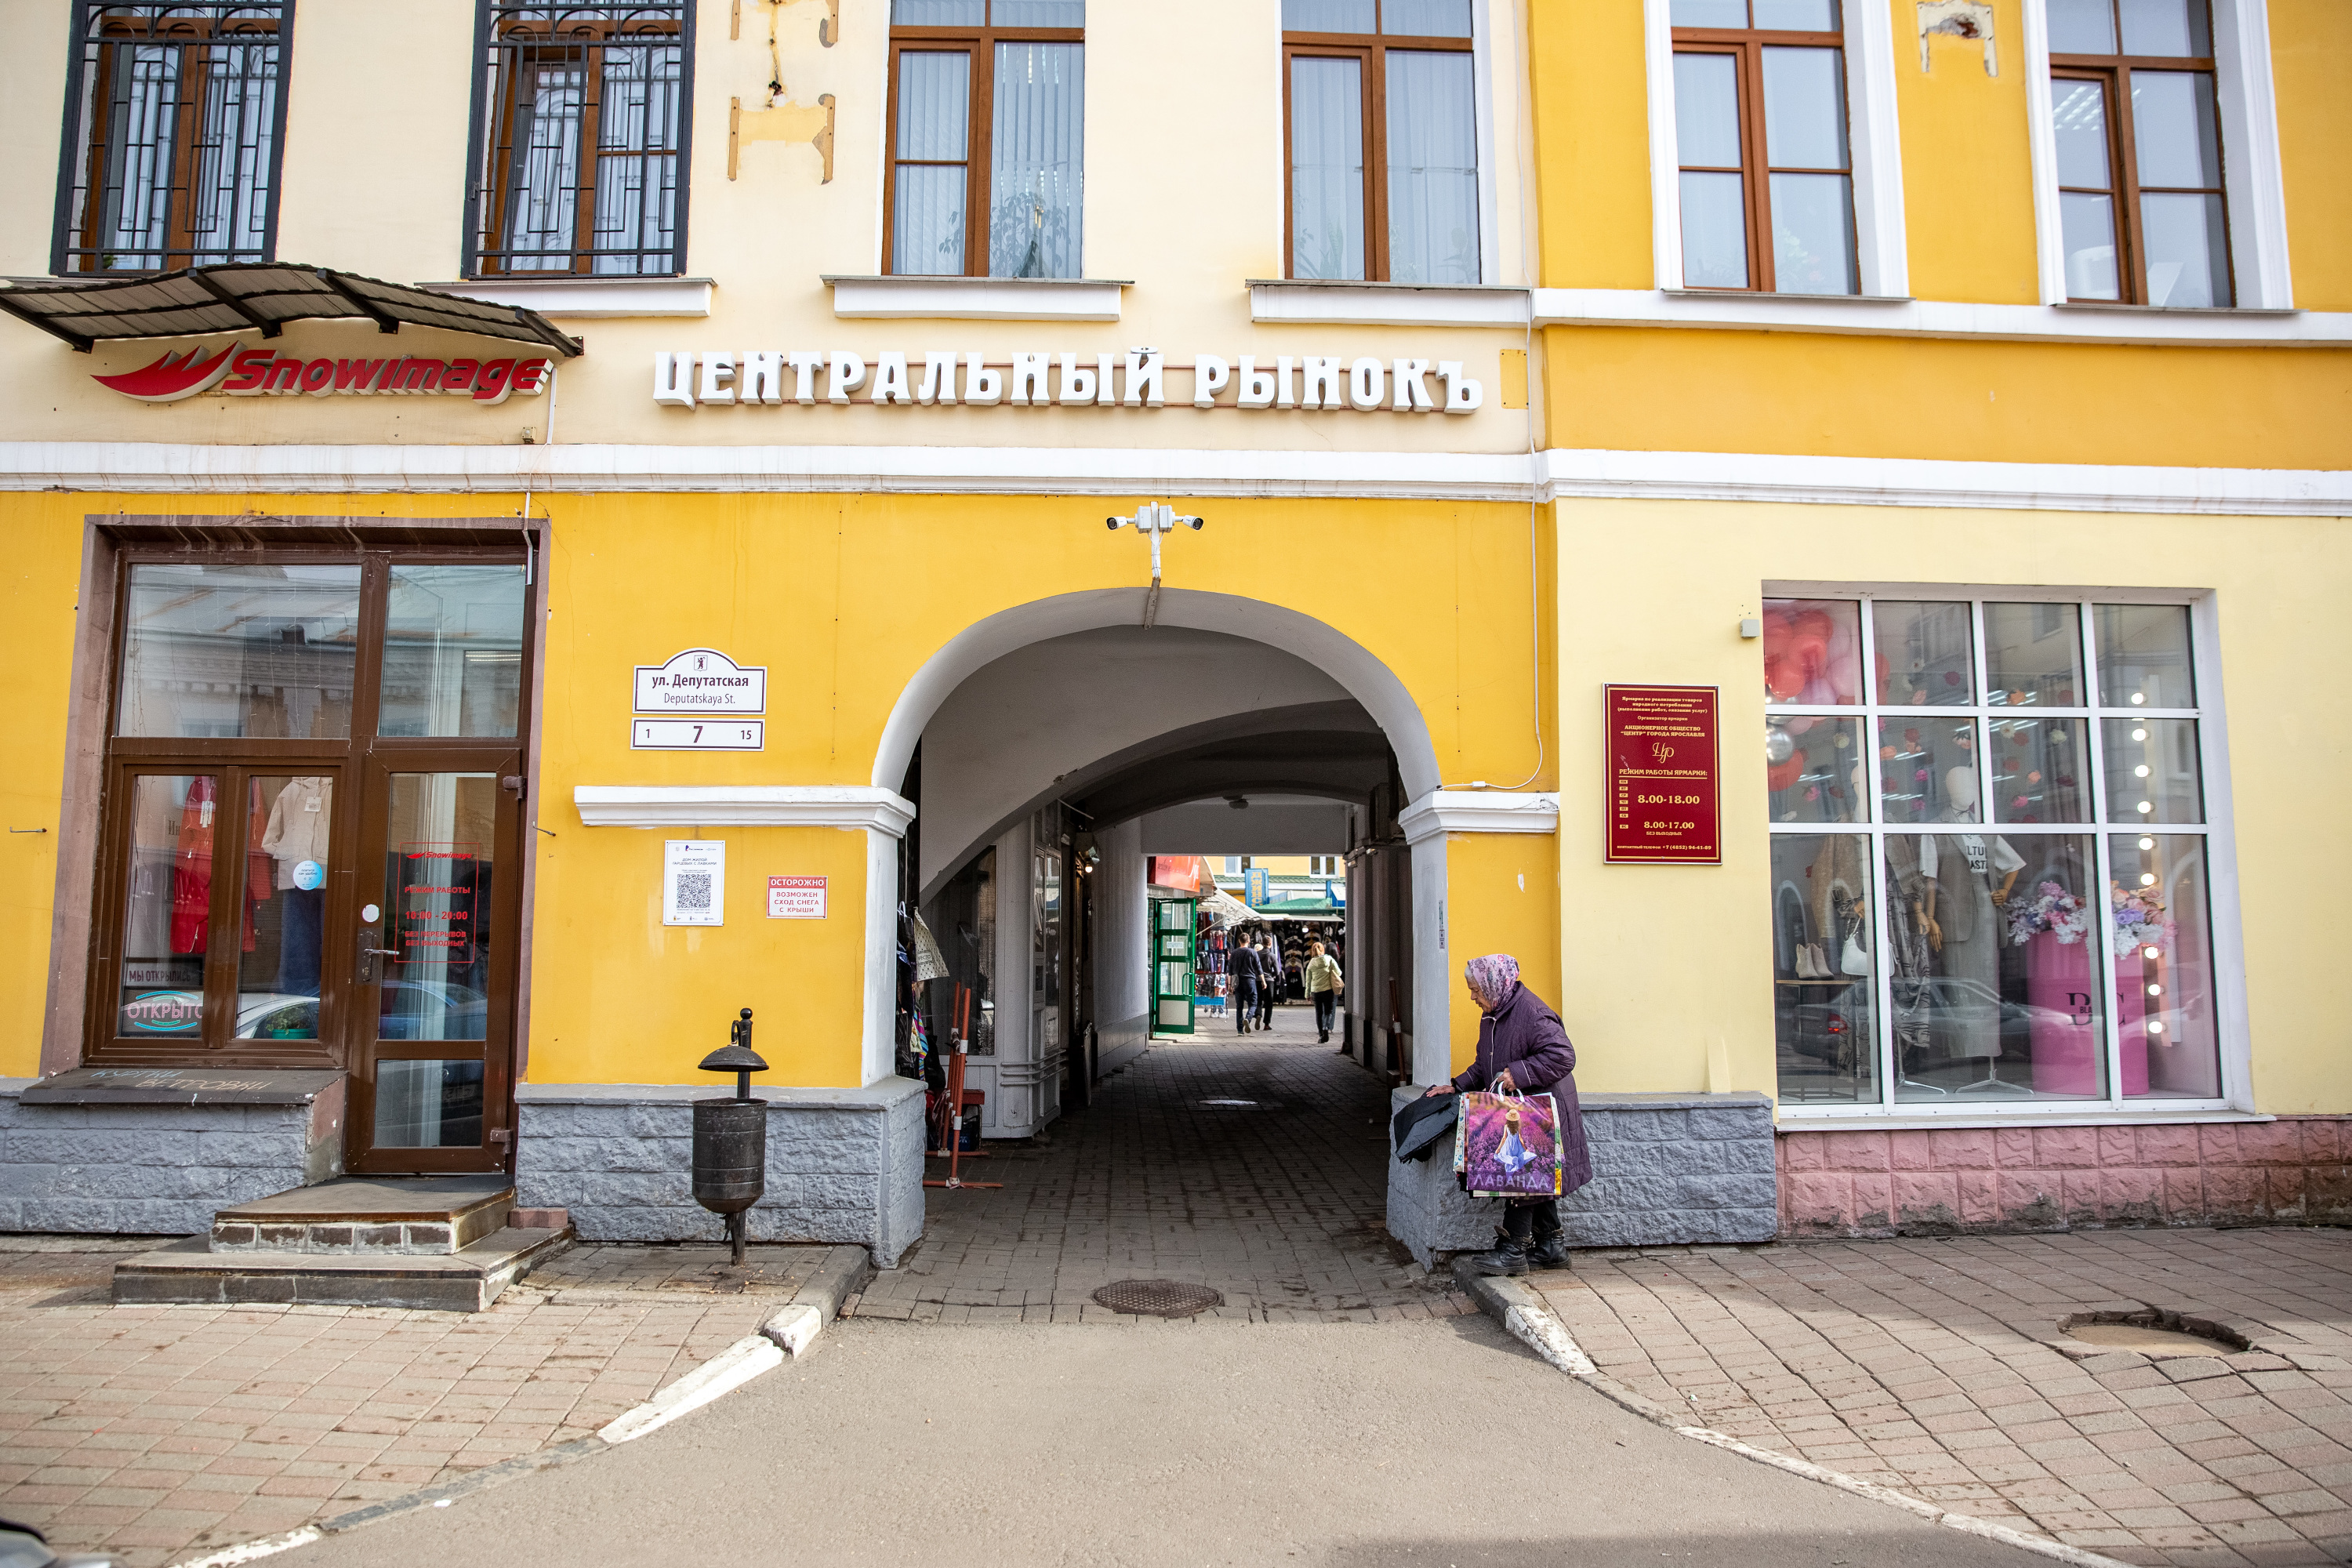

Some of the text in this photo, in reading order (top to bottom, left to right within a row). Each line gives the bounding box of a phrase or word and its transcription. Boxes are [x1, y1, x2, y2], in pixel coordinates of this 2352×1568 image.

[221, 349, 554, 405] Snowimage
[653, 346, 1483, 414] ЦЕНТРАЛЬНЫЙ РЫНОКЪ
[652, 674, 749, 689] ул. Депутатская
[664, 693, 735, 706] Deputatskaya St.
[645, 728, 650, 739] 1
[693, 725, 703, 743] 7
[740, 730, 752, 740] 15
[1638, 794, 1700, 804] 8.00-18.00
[1643, 821, 1695, 829] 8.00-17.00
[425, 851, 473, 860] Snowimage
[405, 911, 431, 920] 10:00
[441, 911, 468, 920] 20:00
[129, 971, 191, 982] МЫ ОТКРЫЛИСЬ
[1473, 1173, 1550, 1189] ЛАВАНДА
